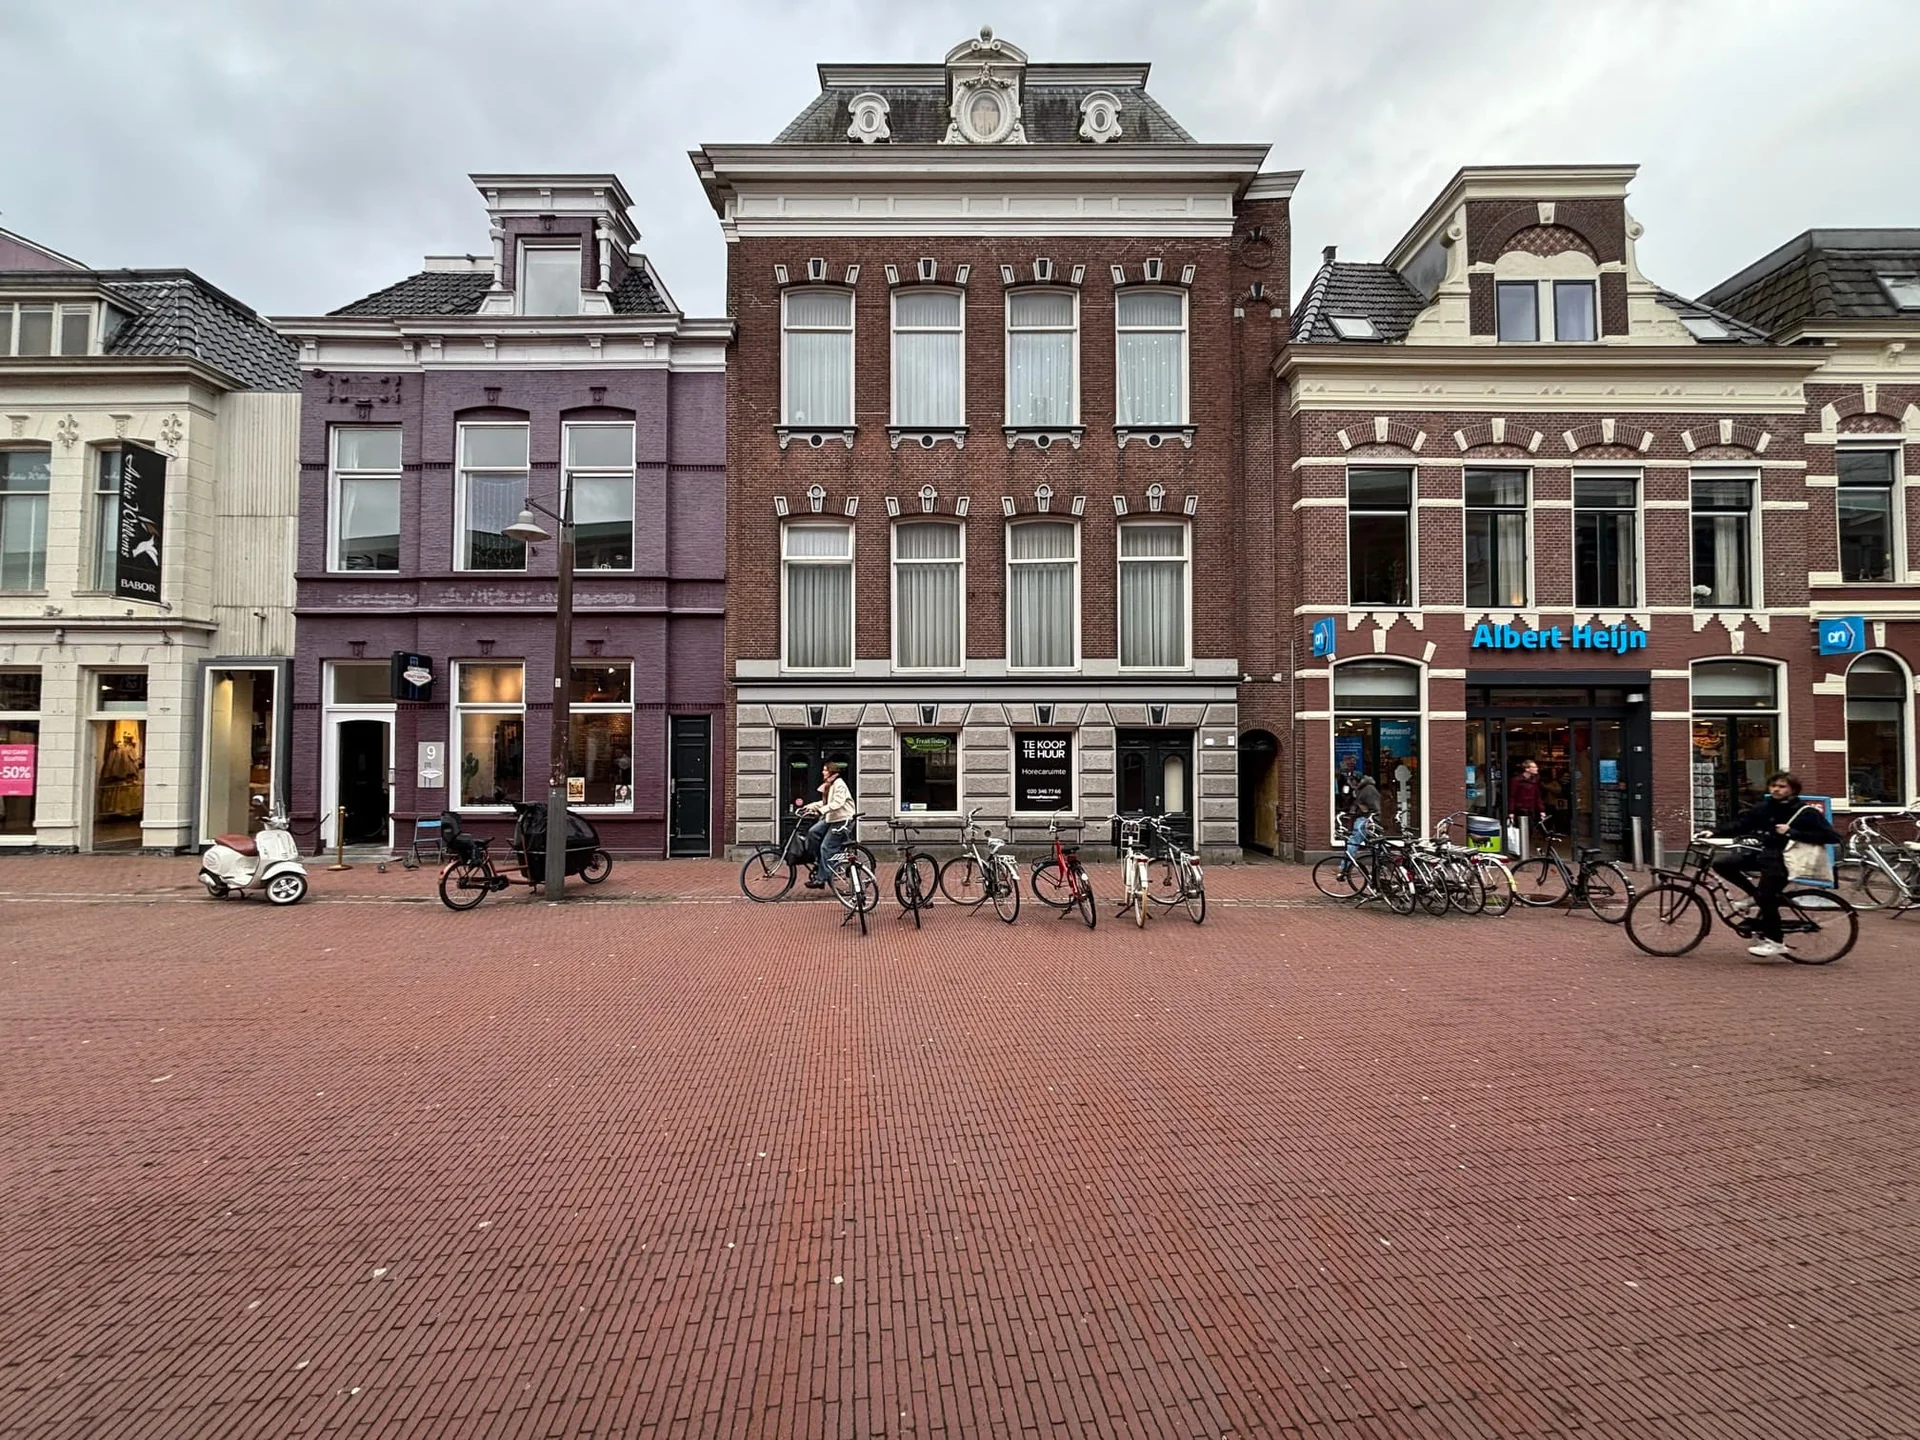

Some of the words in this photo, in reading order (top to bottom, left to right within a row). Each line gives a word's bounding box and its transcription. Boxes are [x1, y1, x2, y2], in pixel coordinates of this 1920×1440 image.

[120, 578, 156, 593] BABOR
[1472, 624, 1563, 648] Albert
[1572, 624, 1647, 654] Heijn
[1022, 740, 1035, 749] TE
[1037, 740, 1066, 749] KOOP
[427, 746, 436, 759] 9
[1022, 750, 1035, 758] TE
[1037, 750, 1065, 758] HUUR
